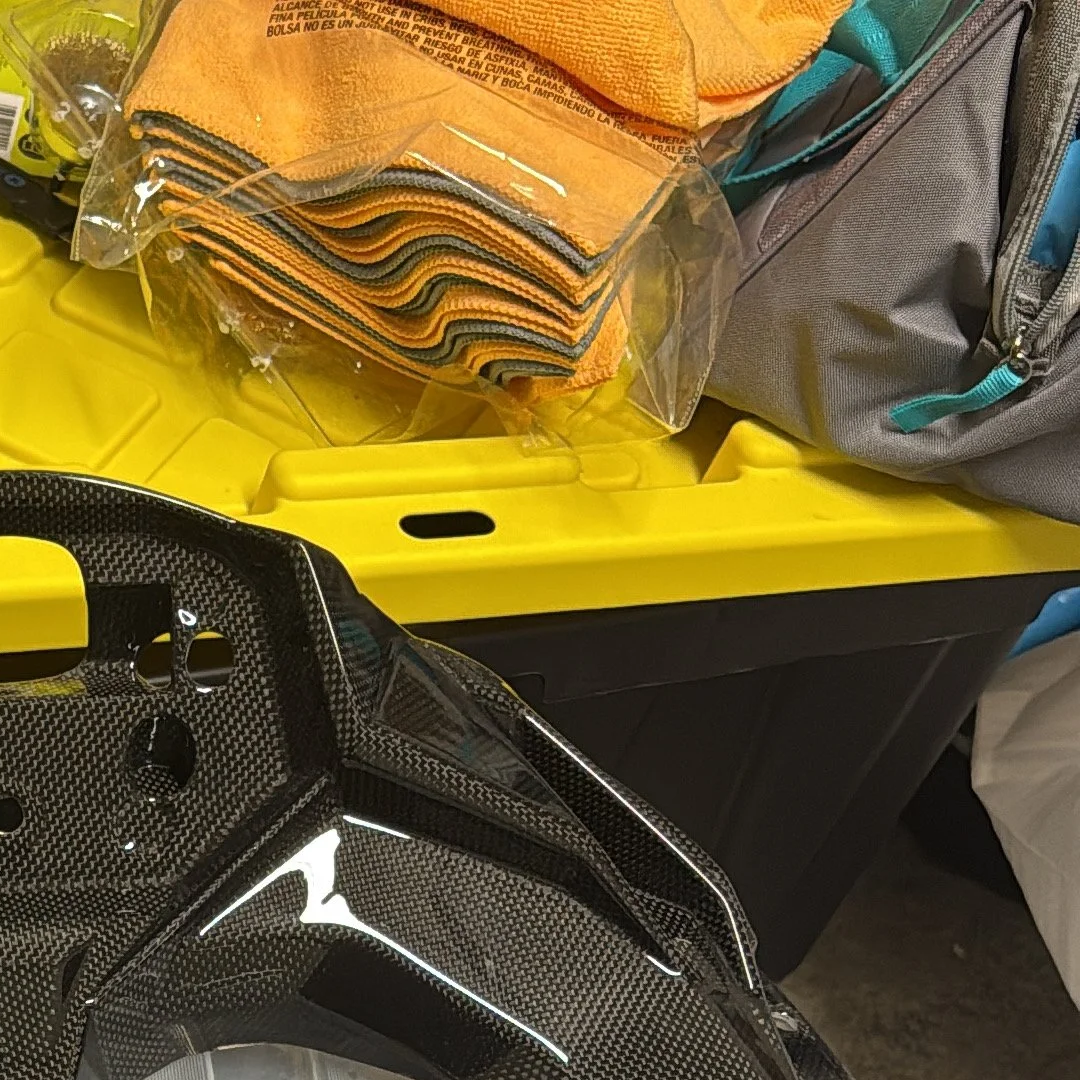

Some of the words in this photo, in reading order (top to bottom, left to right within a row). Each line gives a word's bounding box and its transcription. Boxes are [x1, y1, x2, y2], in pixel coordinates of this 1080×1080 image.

[269, 11, 295, 24] FINA
[377, 4, 399, 17] USE
[400, 10, 412, 20] IN
[266, 22, 301, 38] BOLSA
[303, 20, 320, 33] NO
[321, 19, 337, 30] ES
[338, 19, 354, 29] UN
[387, 18, 410, 30] AND
[413, 24, 459, 43] PREVENT
[423, 37, 463, 54] RIESGO
[466, 47, 482, 59] DE
[436, 51, 466, 66] USAR
[467, 59, 483, 70] EN
[500, 77, 532, 93] BOCA
[532, 86, 597, 120] IMPIDIENDO
